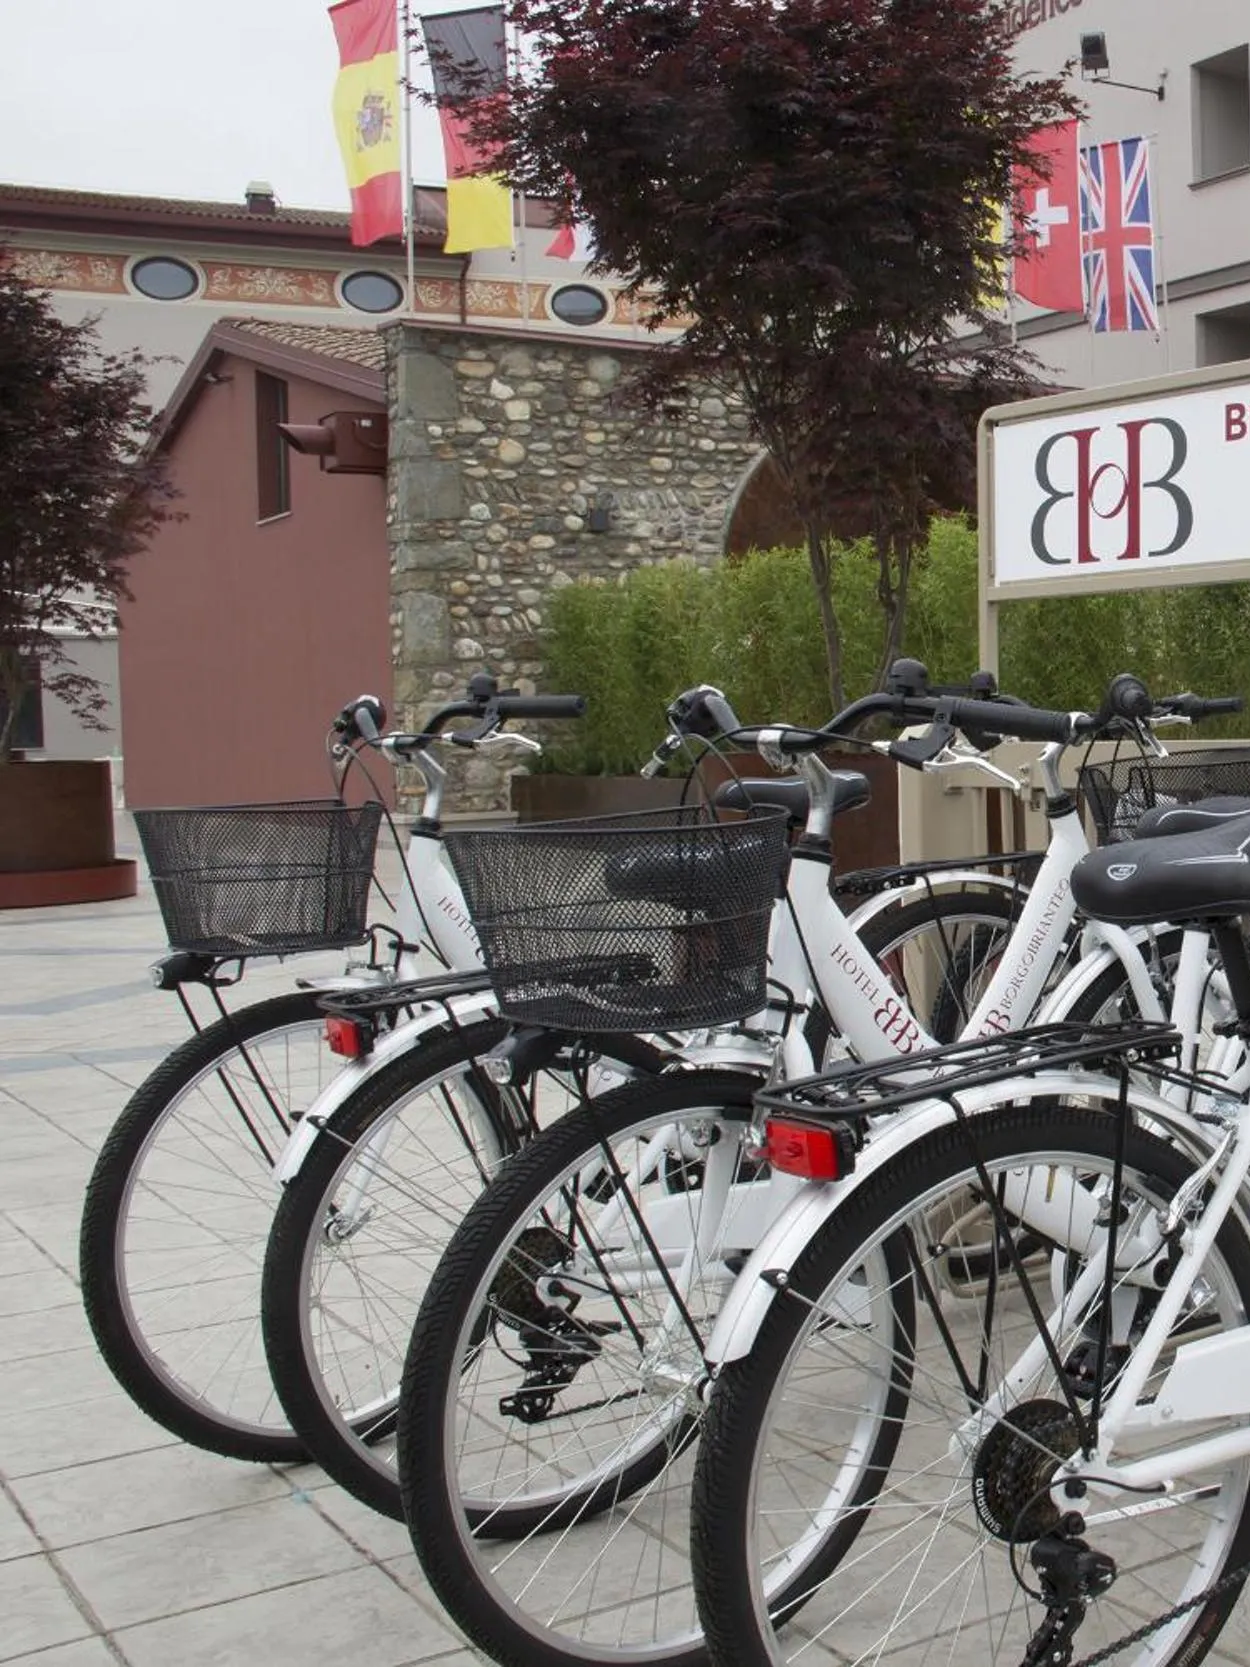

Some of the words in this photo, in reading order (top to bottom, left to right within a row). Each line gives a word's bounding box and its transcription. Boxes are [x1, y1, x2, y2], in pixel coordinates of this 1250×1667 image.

[829, 943, 879, 1005] HOTEL
[1000, 877, 1071, 1010] BORGOBRIANTEO
[975, 1477, 1002, 1533] SHIMANO
